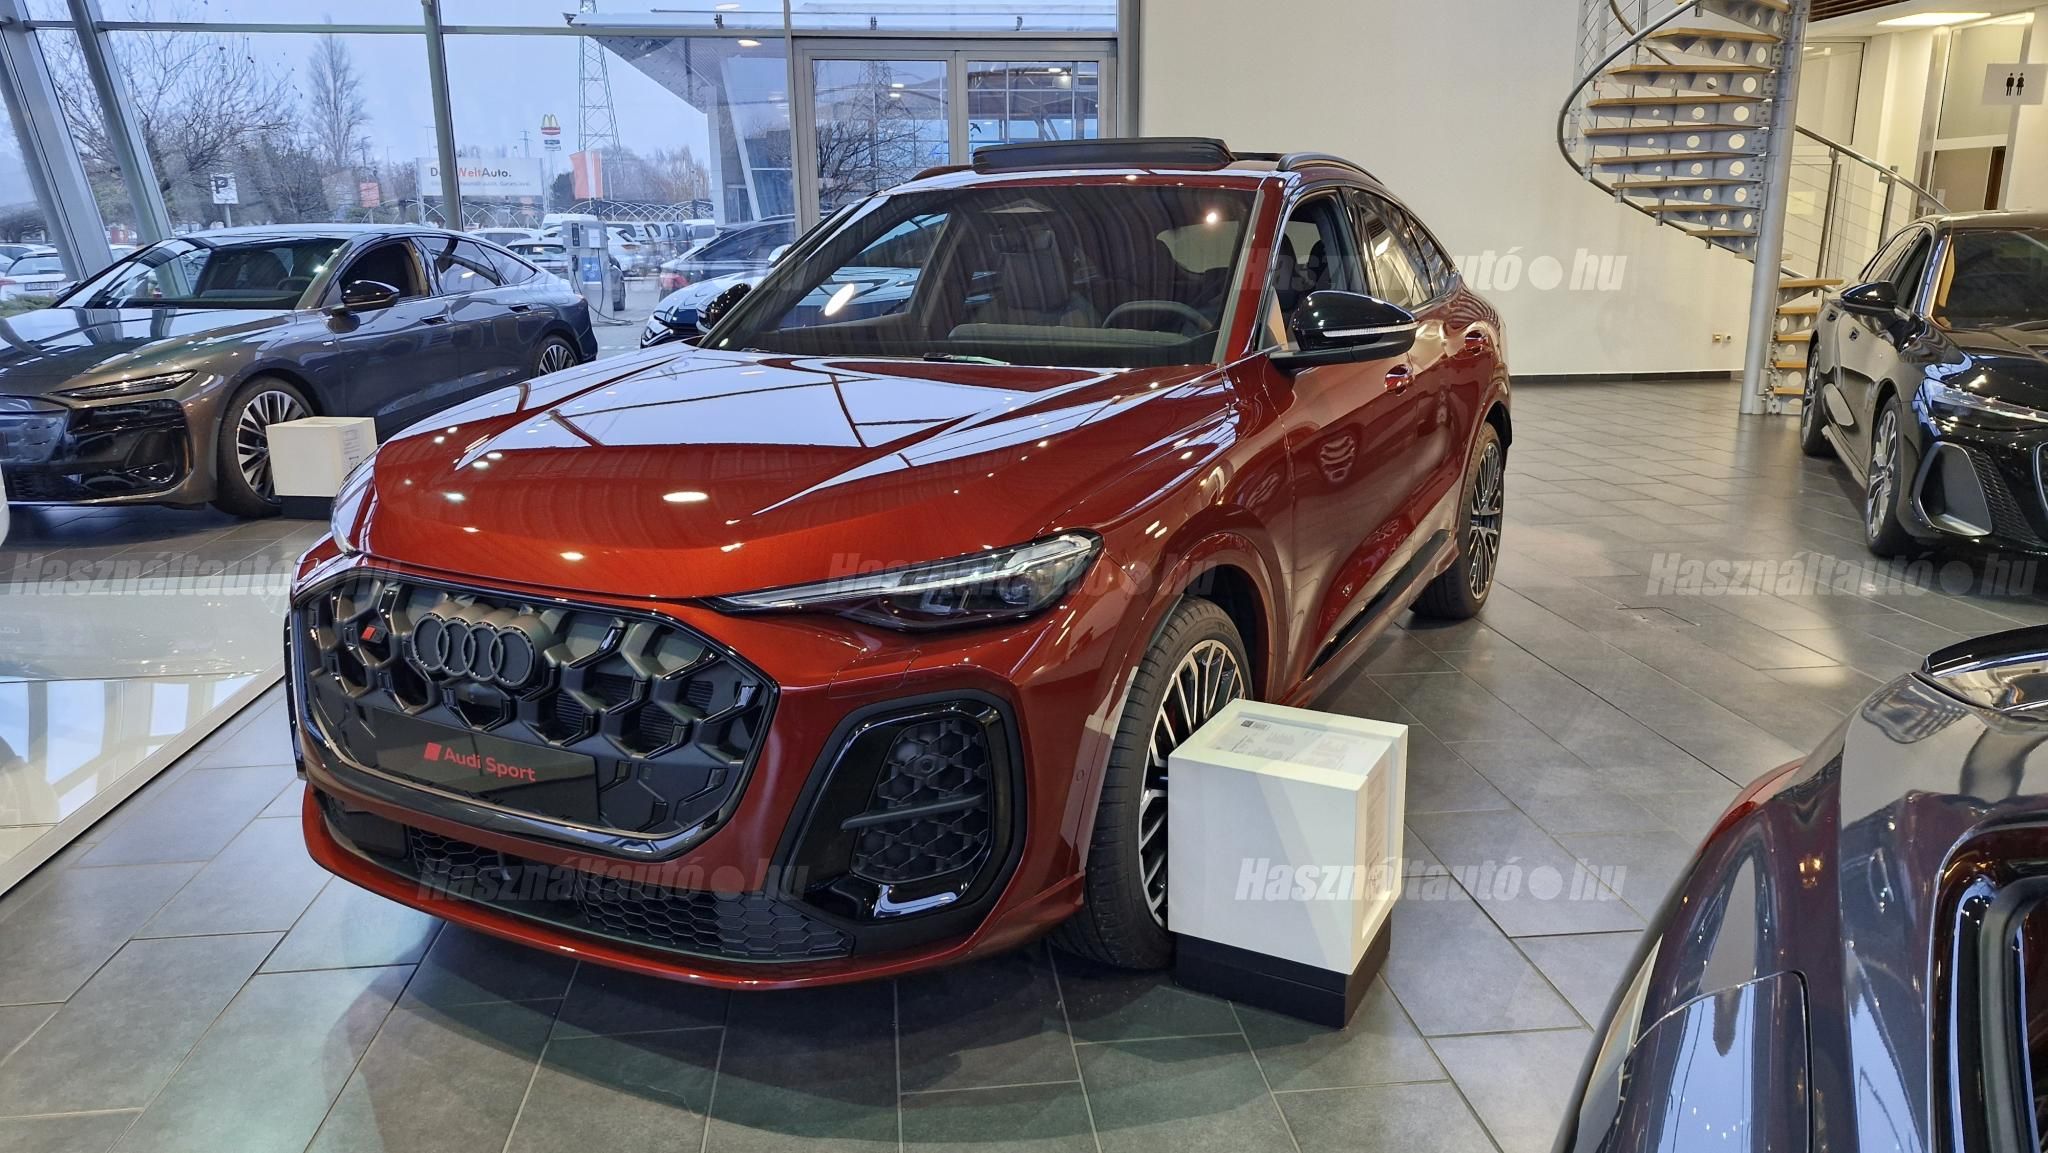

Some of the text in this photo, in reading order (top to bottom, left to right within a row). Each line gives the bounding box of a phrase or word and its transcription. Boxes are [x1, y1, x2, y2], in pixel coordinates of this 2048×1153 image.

[213, 175, 229, 194] P
[443, 747, 536, 782] Audi Sport
